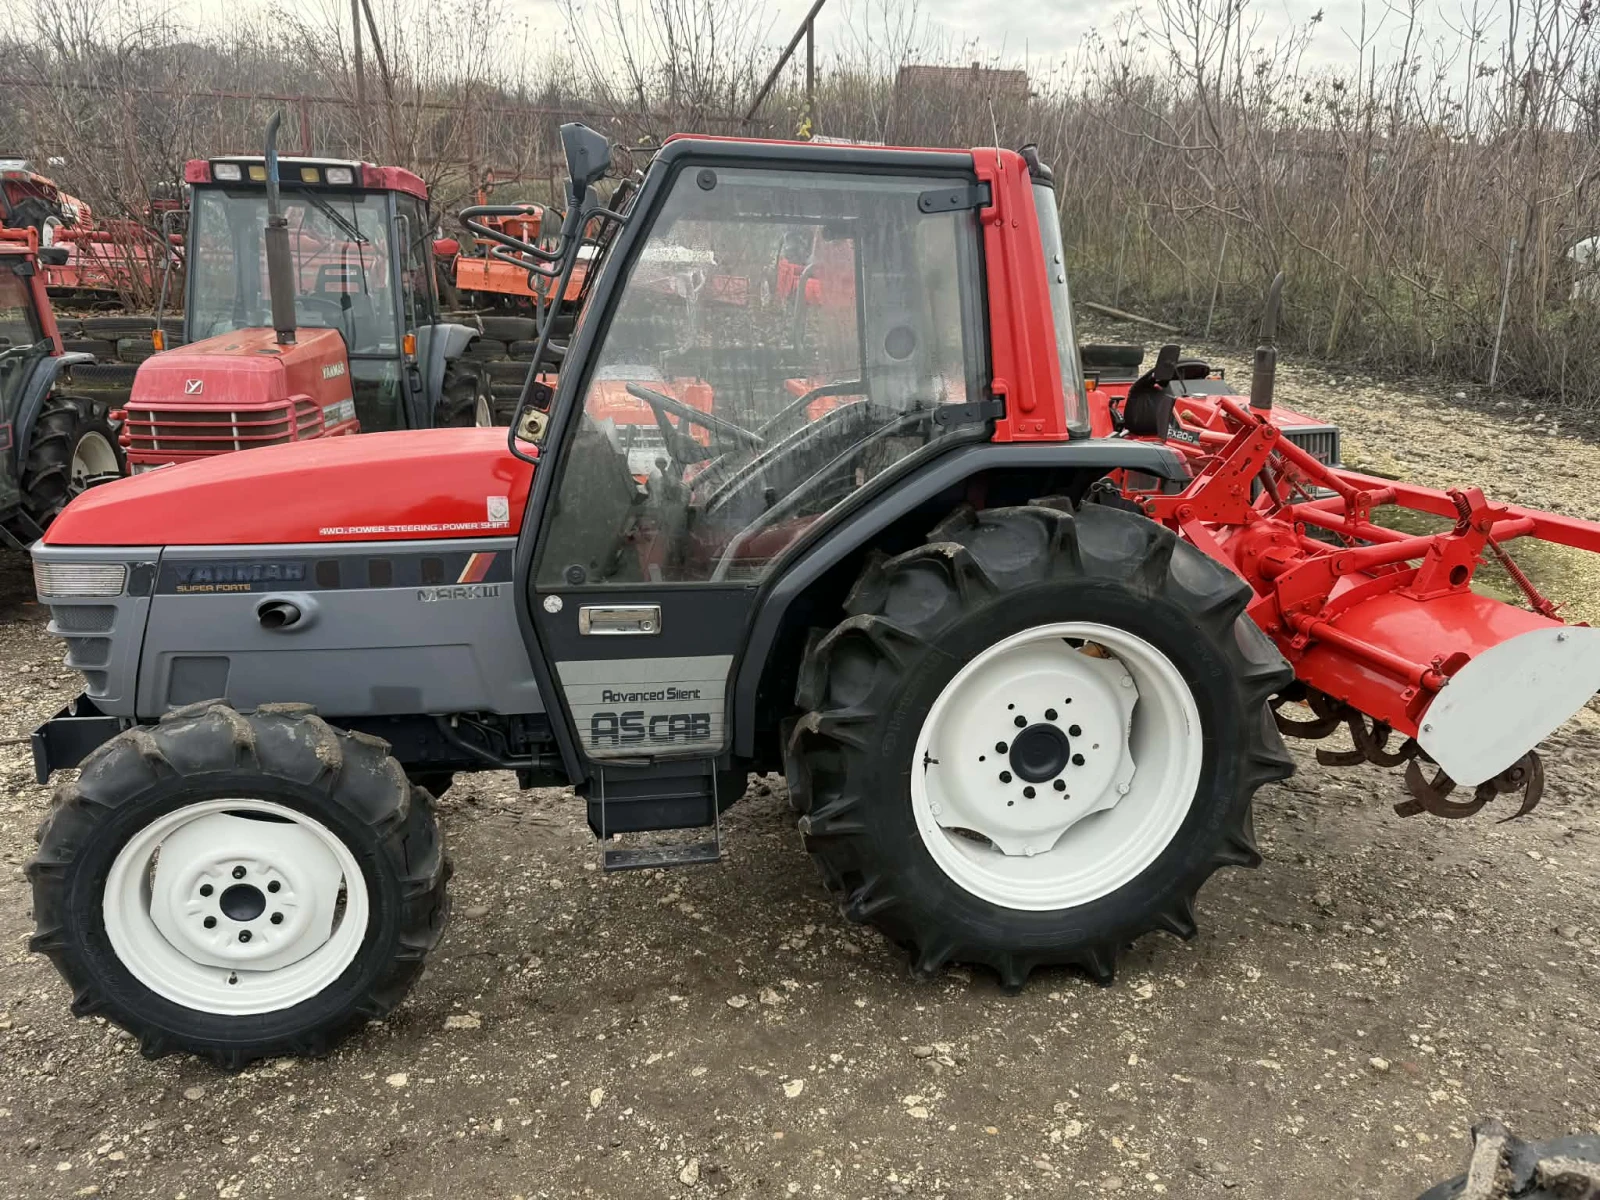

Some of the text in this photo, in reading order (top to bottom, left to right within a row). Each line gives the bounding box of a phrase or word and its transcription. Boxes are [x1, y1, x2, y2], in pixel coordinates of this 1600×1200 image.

[480, 521, 510, 529] SHIFT
[176, 583, 251, 592] SUPER FORTE
[602, 687, 701, 702] Advanced Silent
